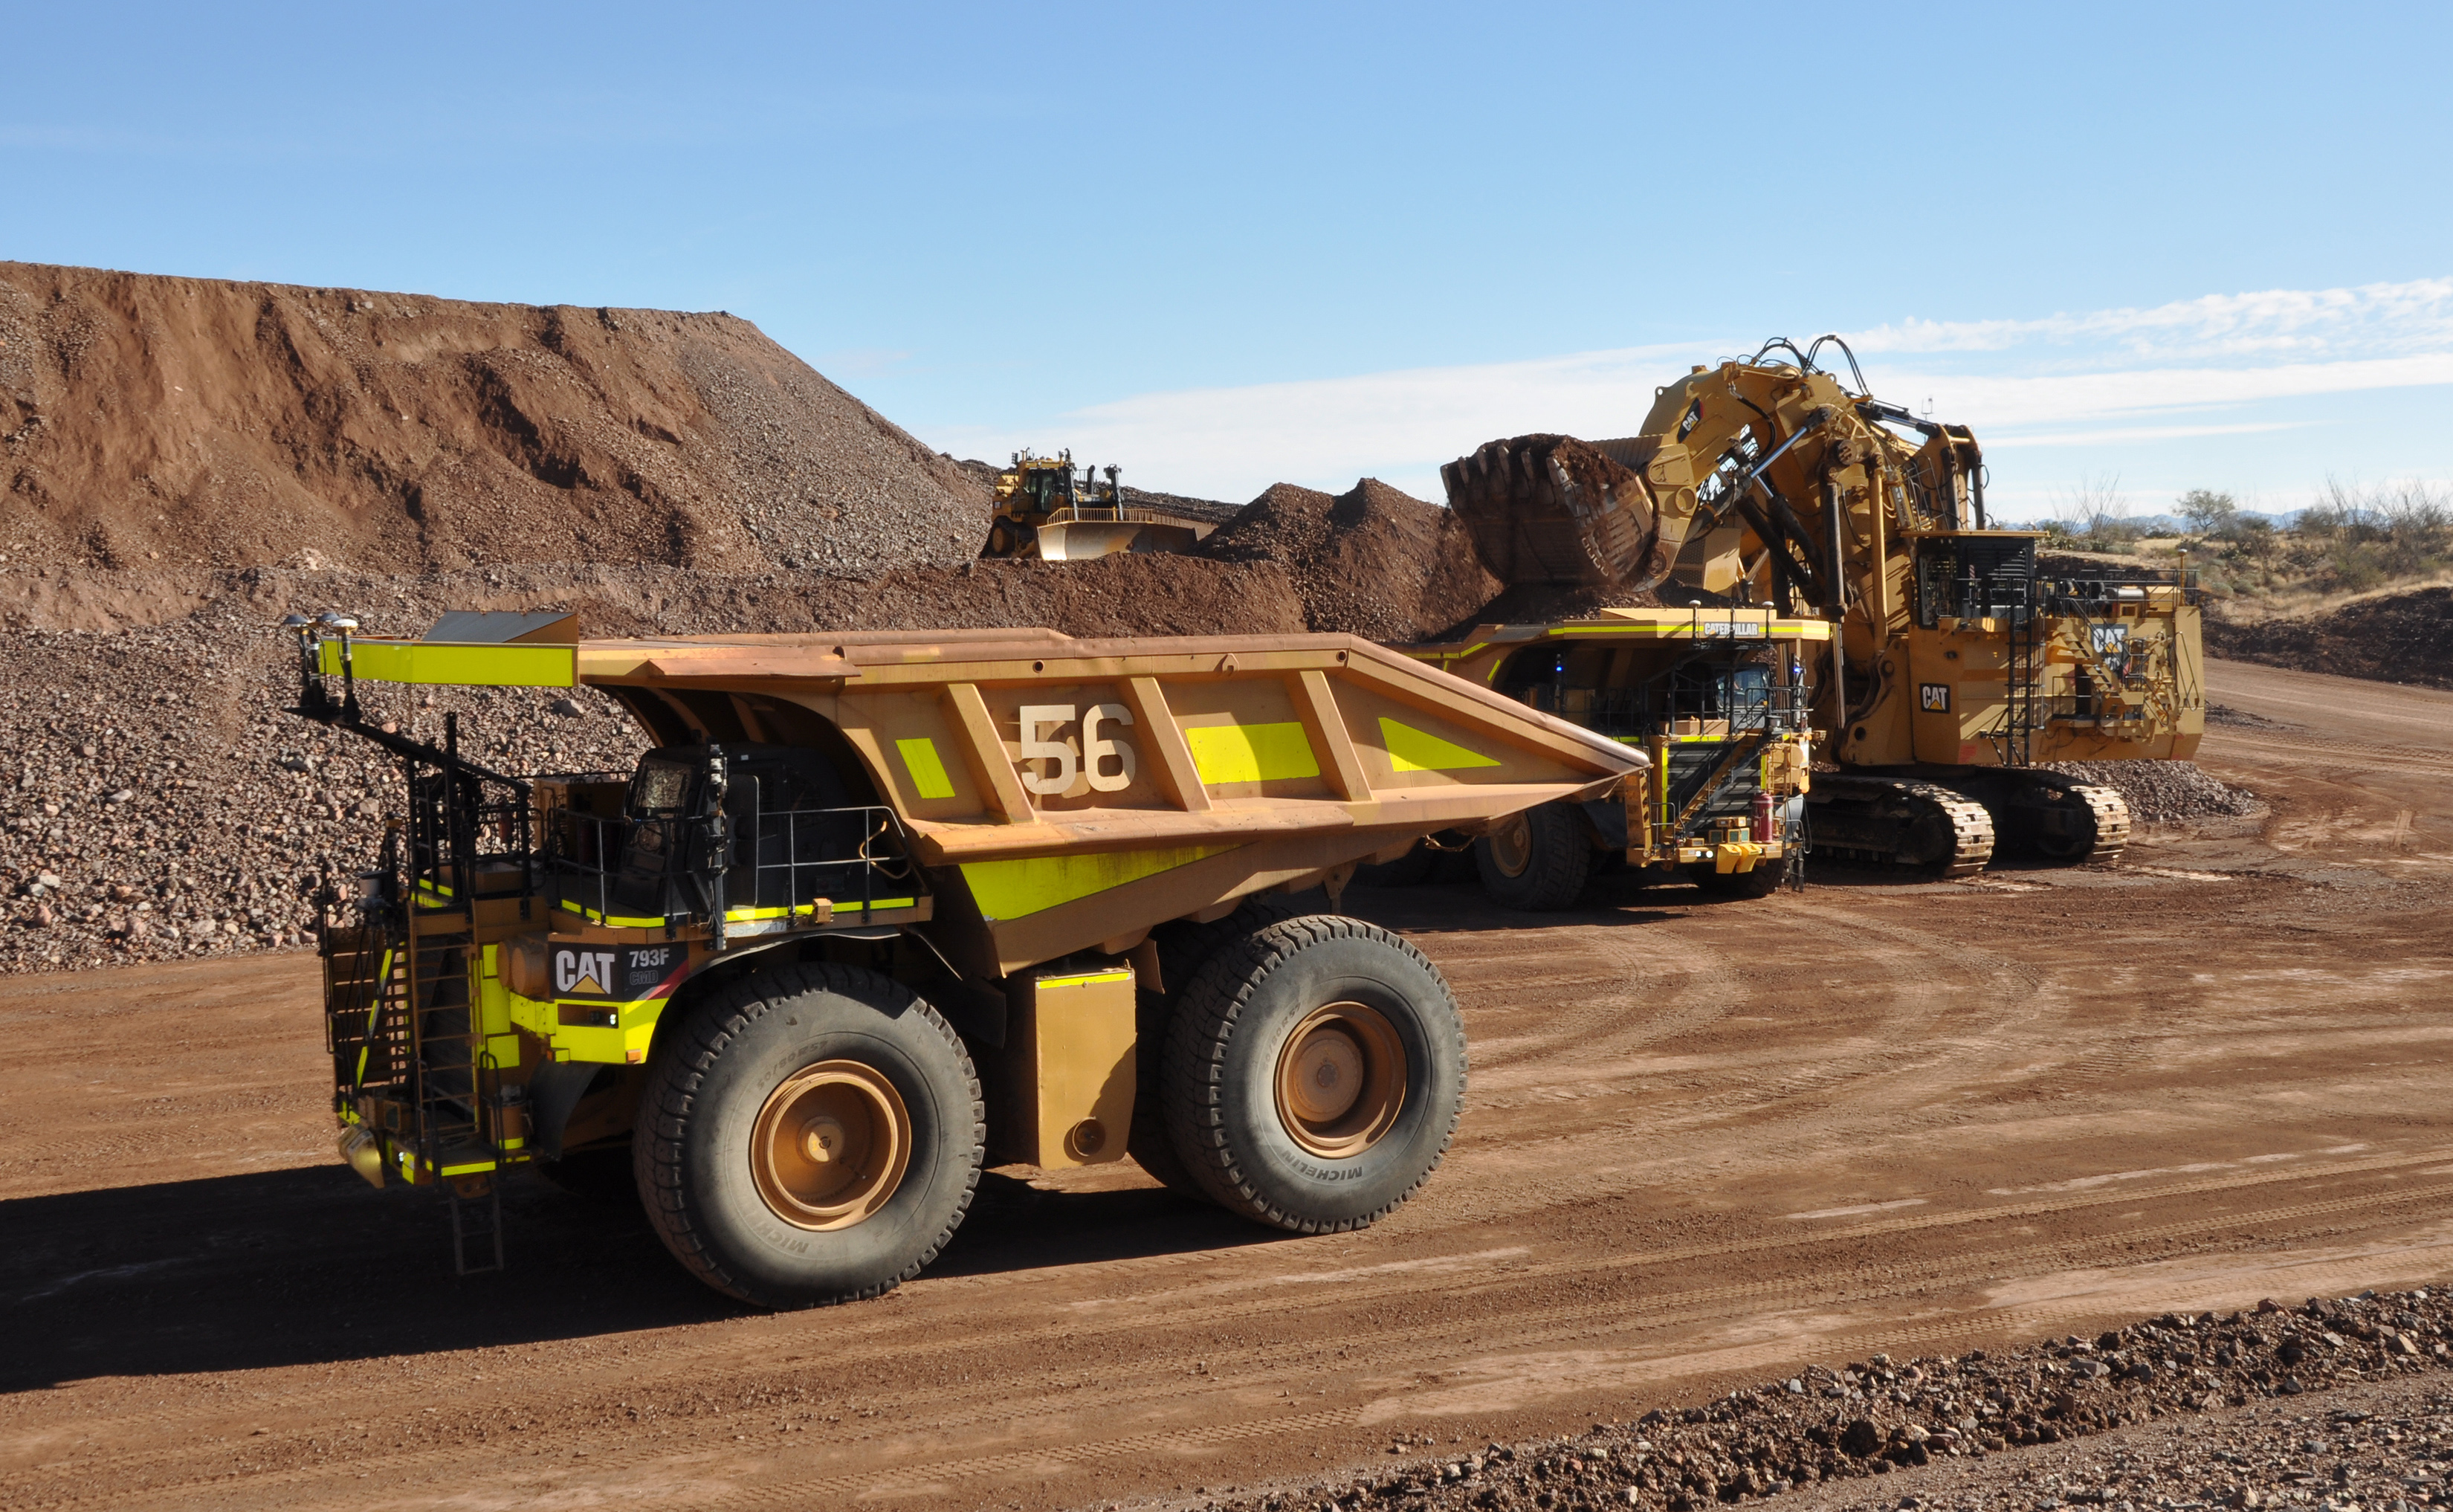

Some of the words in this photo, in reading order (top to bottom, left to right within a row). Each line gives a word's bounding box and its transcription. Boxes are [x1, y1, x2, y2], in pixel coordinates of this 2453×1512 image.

[1682, 411, 1699, 431] CAT
[2093, 628, 2124, 653] CAT
[1922, 685, 1947, 711] CAT
[1020, 704, 1136, 795] 56
[630, 948, 669, 968] 793F
[556, 950, 615, 995] CAT
[630, 970, 658, 985] CMD
[1282, 1150, 1363, 1181] MICHELIN
